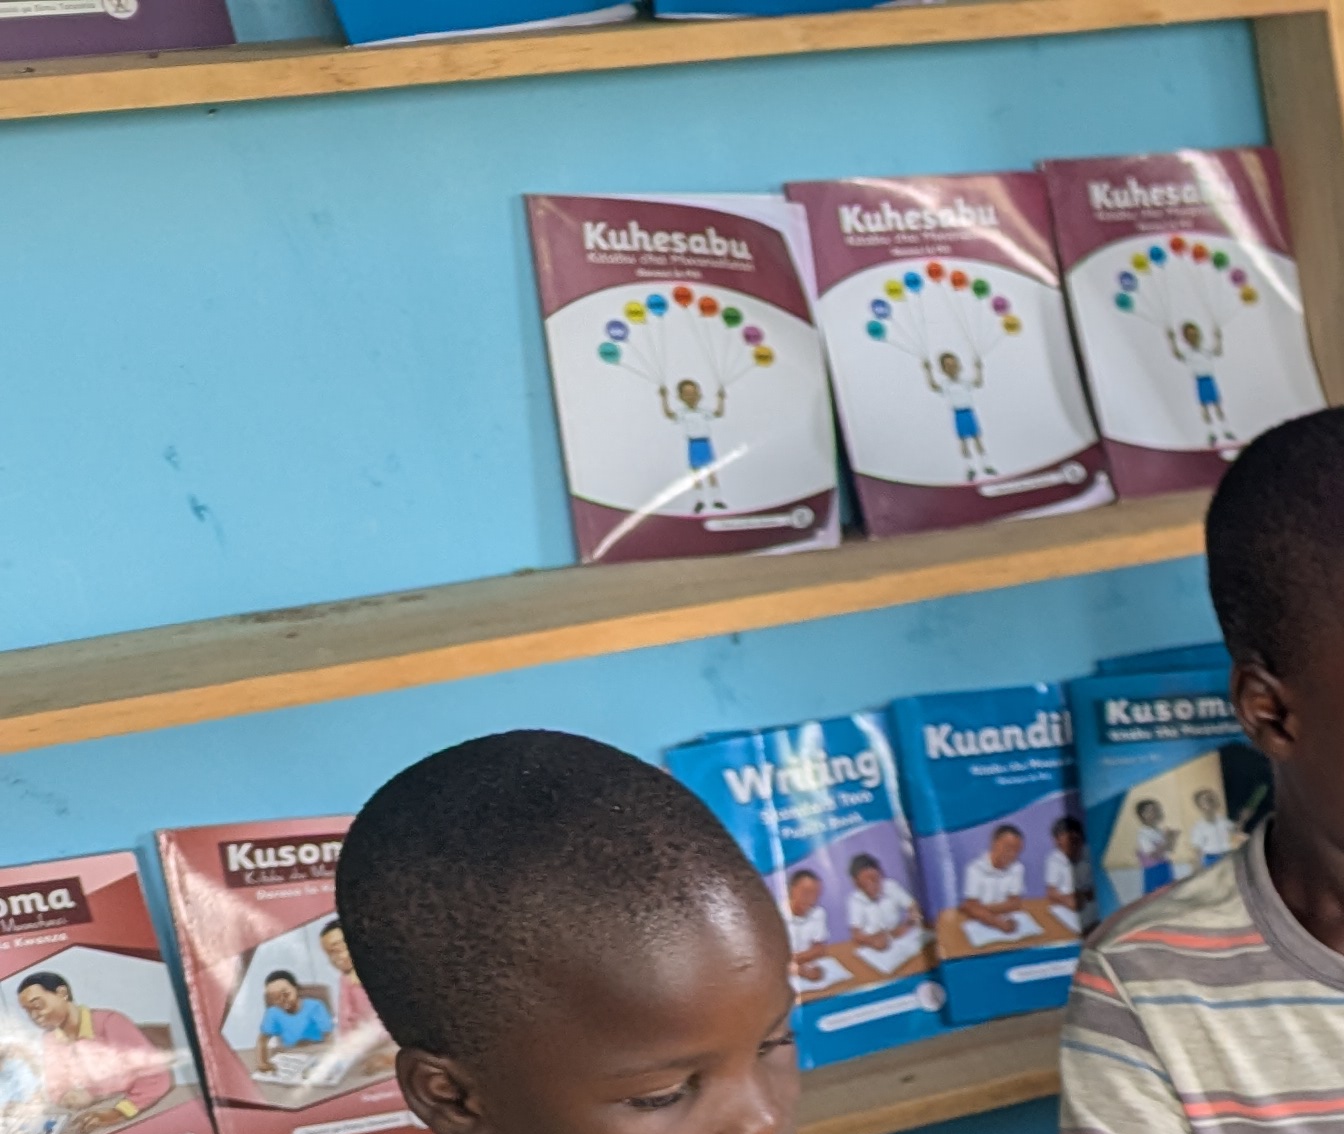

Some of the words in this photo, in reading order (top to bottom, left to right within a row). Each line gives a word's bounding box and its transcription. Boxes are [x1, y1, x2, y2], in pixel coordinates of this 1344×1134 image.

[838, 197, 998, 234] Kuhesabu
[582, 219, 754, 261] Kuhesabu
[1104, 697, 1236, 726] Kusom
[722, 749, 882, 805] Writing
[227, 841, 344, 872] Kusom
